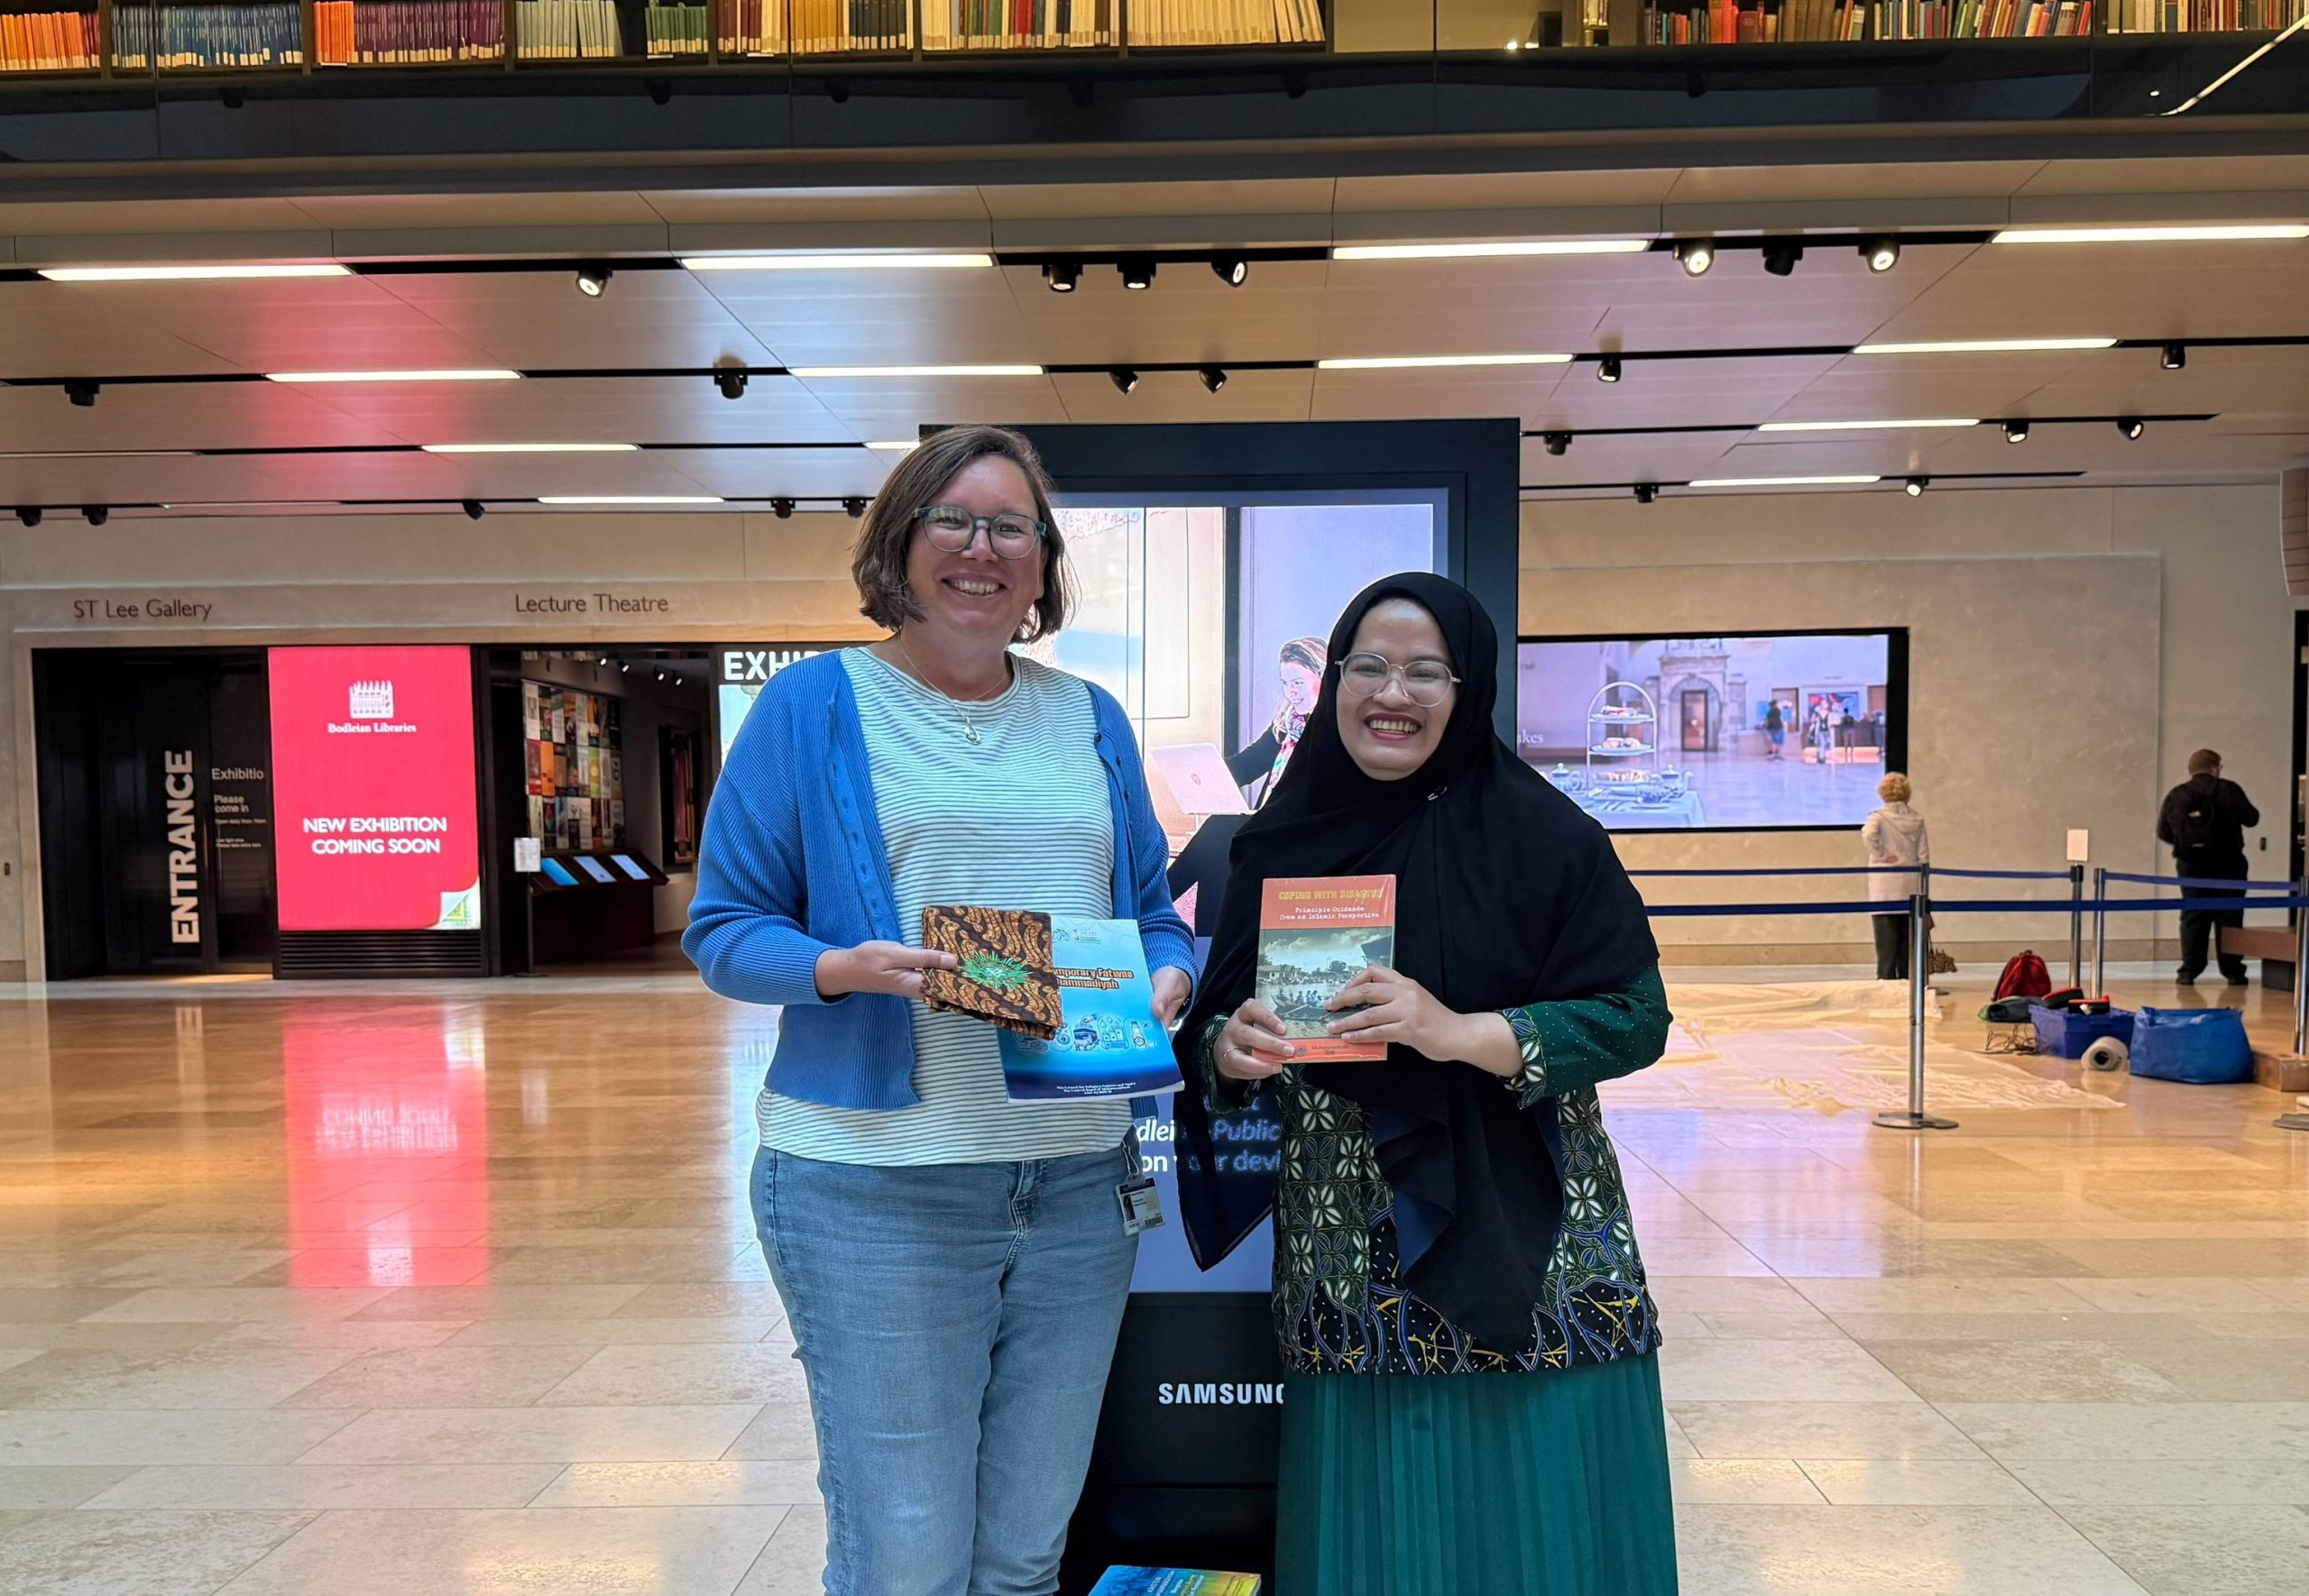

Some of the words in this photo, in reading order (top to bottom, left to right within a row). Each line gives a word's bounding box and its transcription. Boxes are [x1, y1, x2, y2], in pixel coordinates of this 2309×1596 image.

[515, 593, 587, 613] Lecture
[593, 592, 669, 613] Theatre
[73, 599, 99, 619] ST
[106, 599, 140, 619] Lee
[145, 598, 213, 622] Gallery
[723, 650, 823, 681] EXH
[327, 722, 372, 734] Bodleian
[373, 721, 418, 733] Libraries
[211, 767, 264, 781] Exhibitio
[214, 793, 245, 804] Please
[215, 804, 239, 813] come
[240, 804, 250, 813] in
[302, 817, 347, 833] NEW
[349, 816, 448, 833] EXHIBITION
[164, 749, 201, 943] ENTRANCE
[310, 838, 386, 855] COMING
[387, 837, 441, 854] SOON
[1278, 890, 1311, 900] COPING
[1313, 890, 1338, 899] WITH
[1294, 906, 1331, 914] Principle
[1308, 912, 1336, 920] Islamic
[1338, 912, 1380, 921] Perspective
[1053, 968, 1097, 979] mporary
